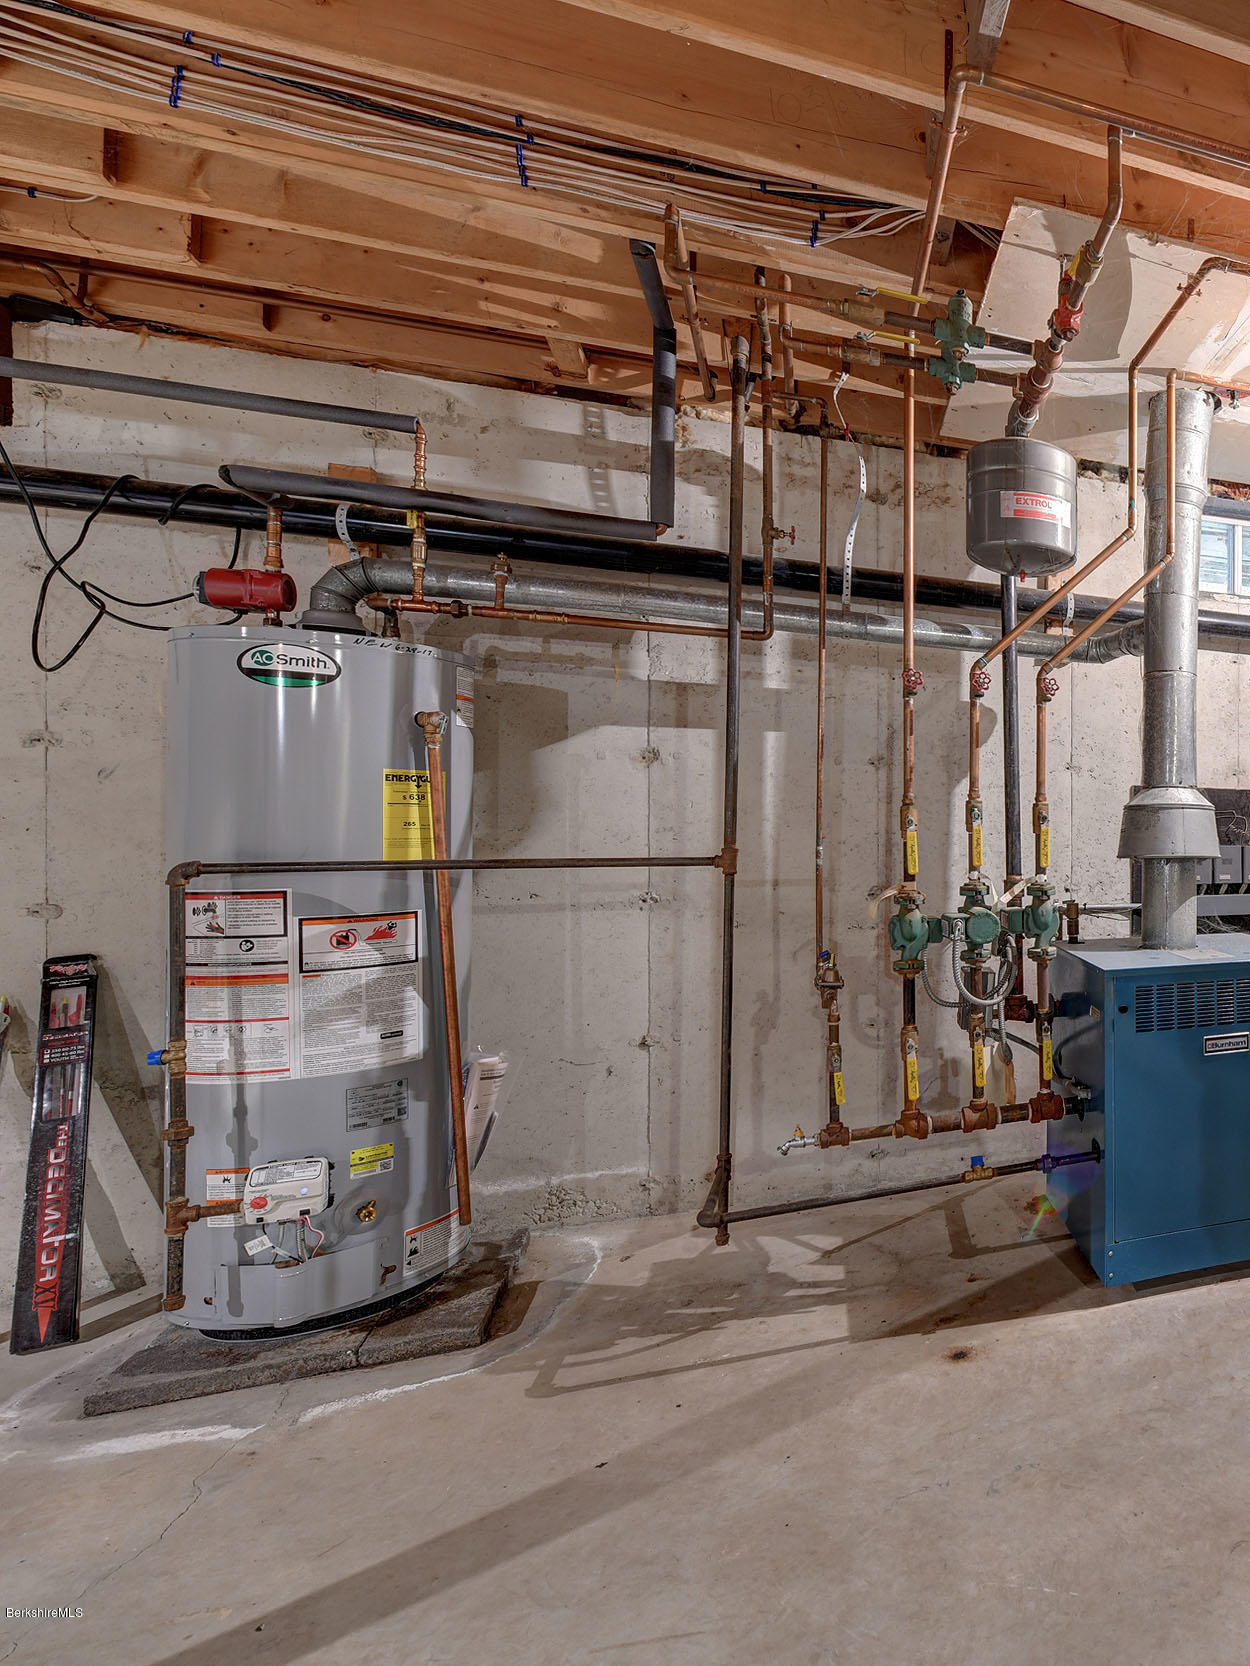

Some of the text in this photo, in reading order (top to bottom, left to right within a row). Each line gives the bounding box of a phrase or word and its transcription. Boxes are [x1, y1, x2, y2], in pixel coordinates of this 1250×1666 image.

[1016, 497, 1053, 510] EXTROL
[1211, 1040, 1247, 1049] Burnham
[40, 1147, 70, 1282] DECIMATOR
